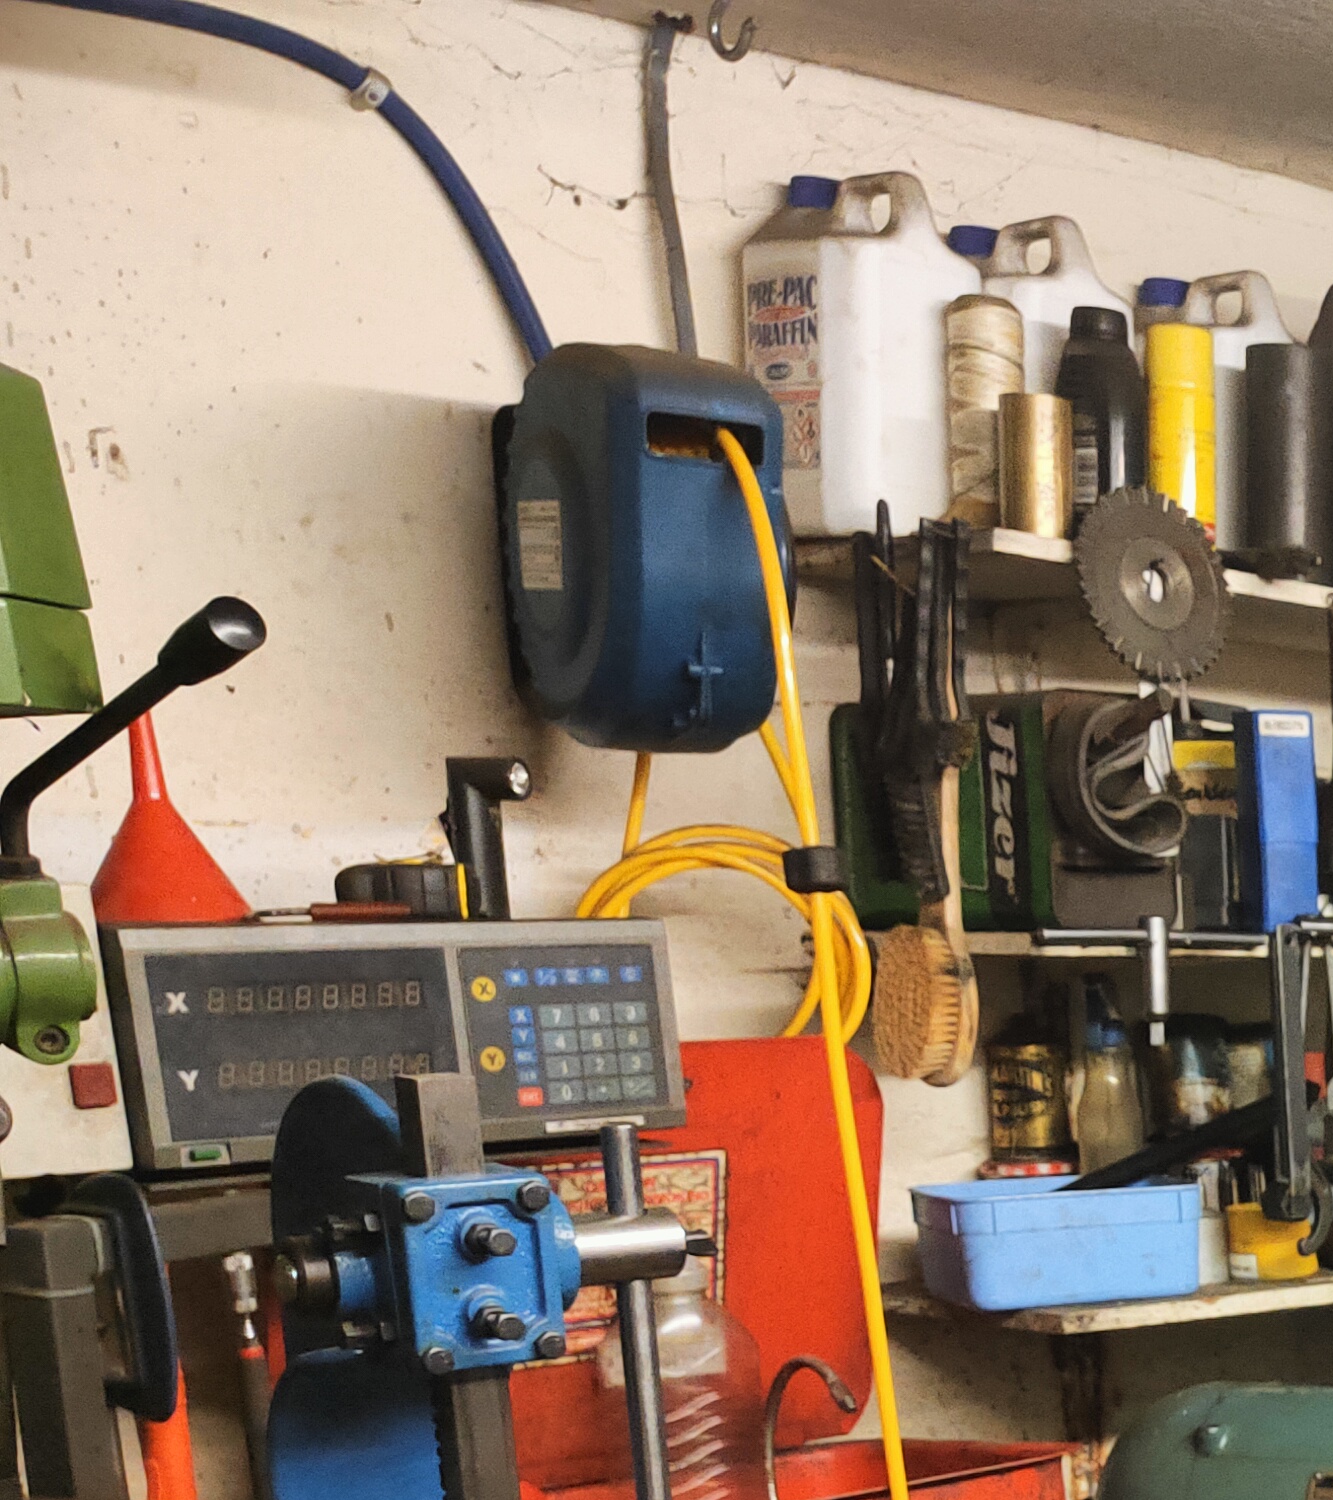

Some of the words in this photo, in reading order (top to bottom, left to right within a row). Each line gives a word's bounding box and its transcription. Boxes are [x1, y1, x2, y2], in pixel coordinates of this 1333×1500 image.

[749, 314, 818, 348] PARAFFIN
[166, 991, 190, 1014] X
[177, 1069, 199, 1092] Y
